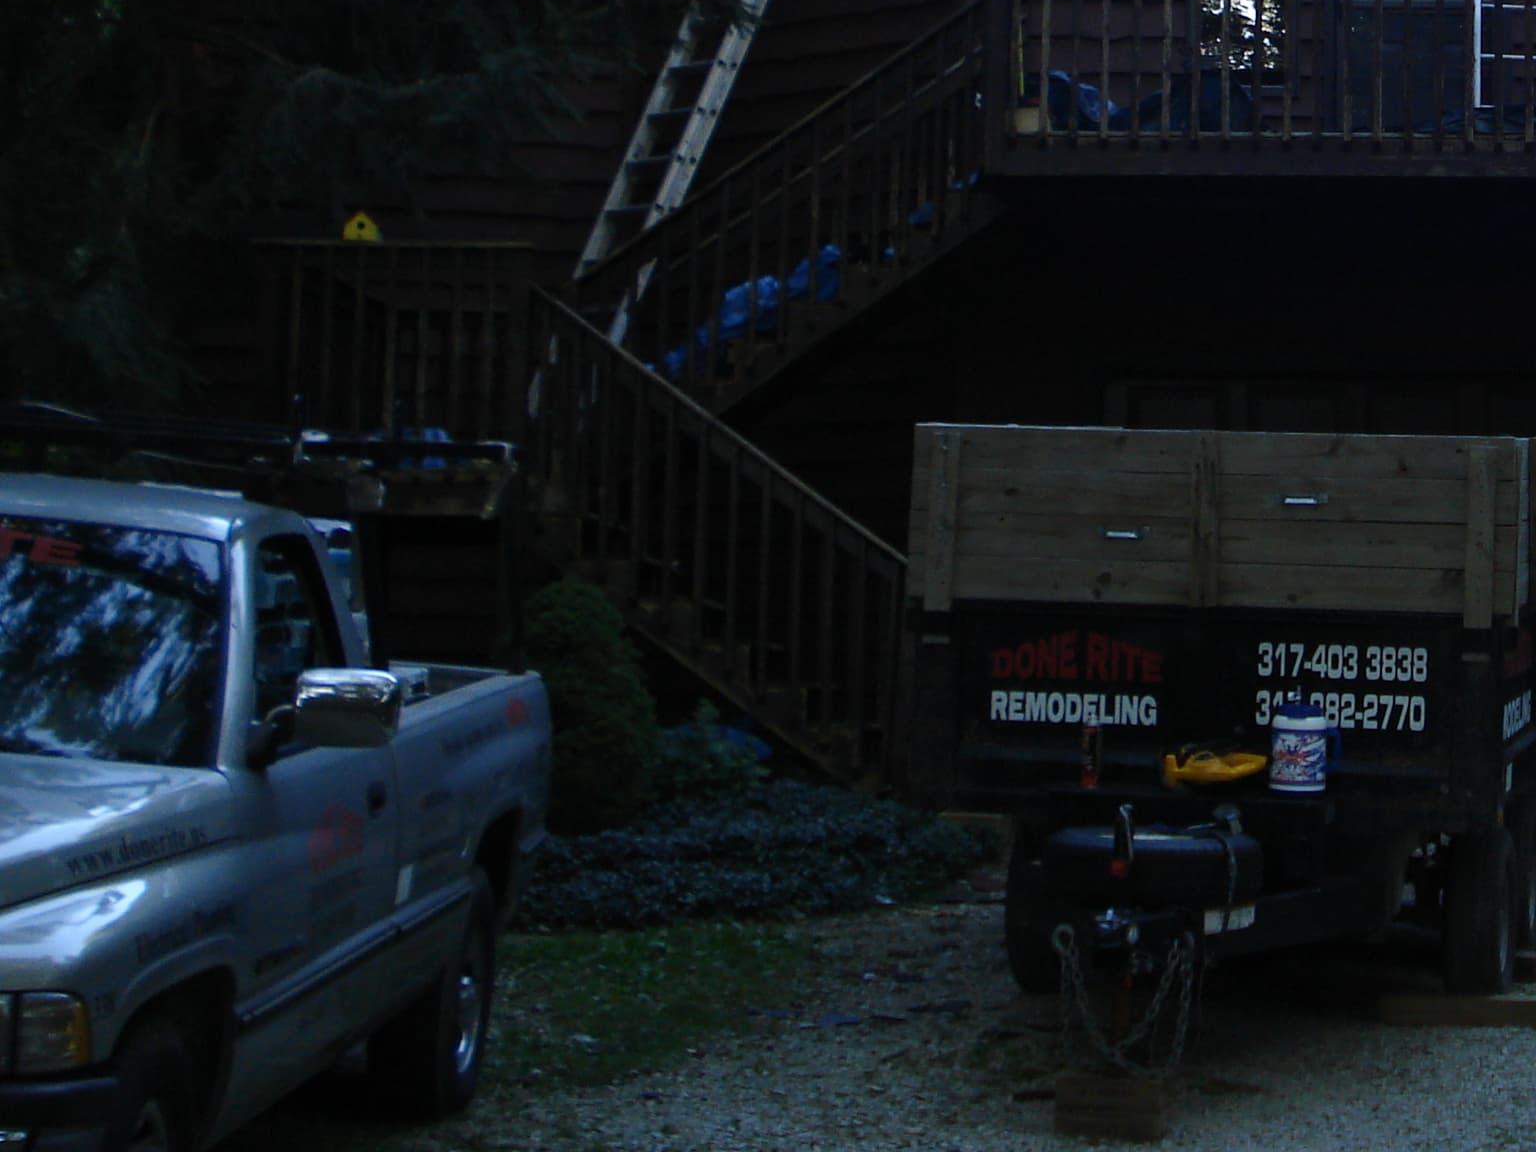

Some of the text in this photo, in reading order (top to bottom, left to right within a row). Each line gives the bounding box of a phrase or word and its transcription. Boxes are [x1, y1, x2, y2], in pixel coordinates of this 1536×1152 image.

[991, 630, 1164, 684] DONE RITE
[1257, 641, 1429, 683] 317-403 3838
[989, 690, 1158, 727] REMODELING
